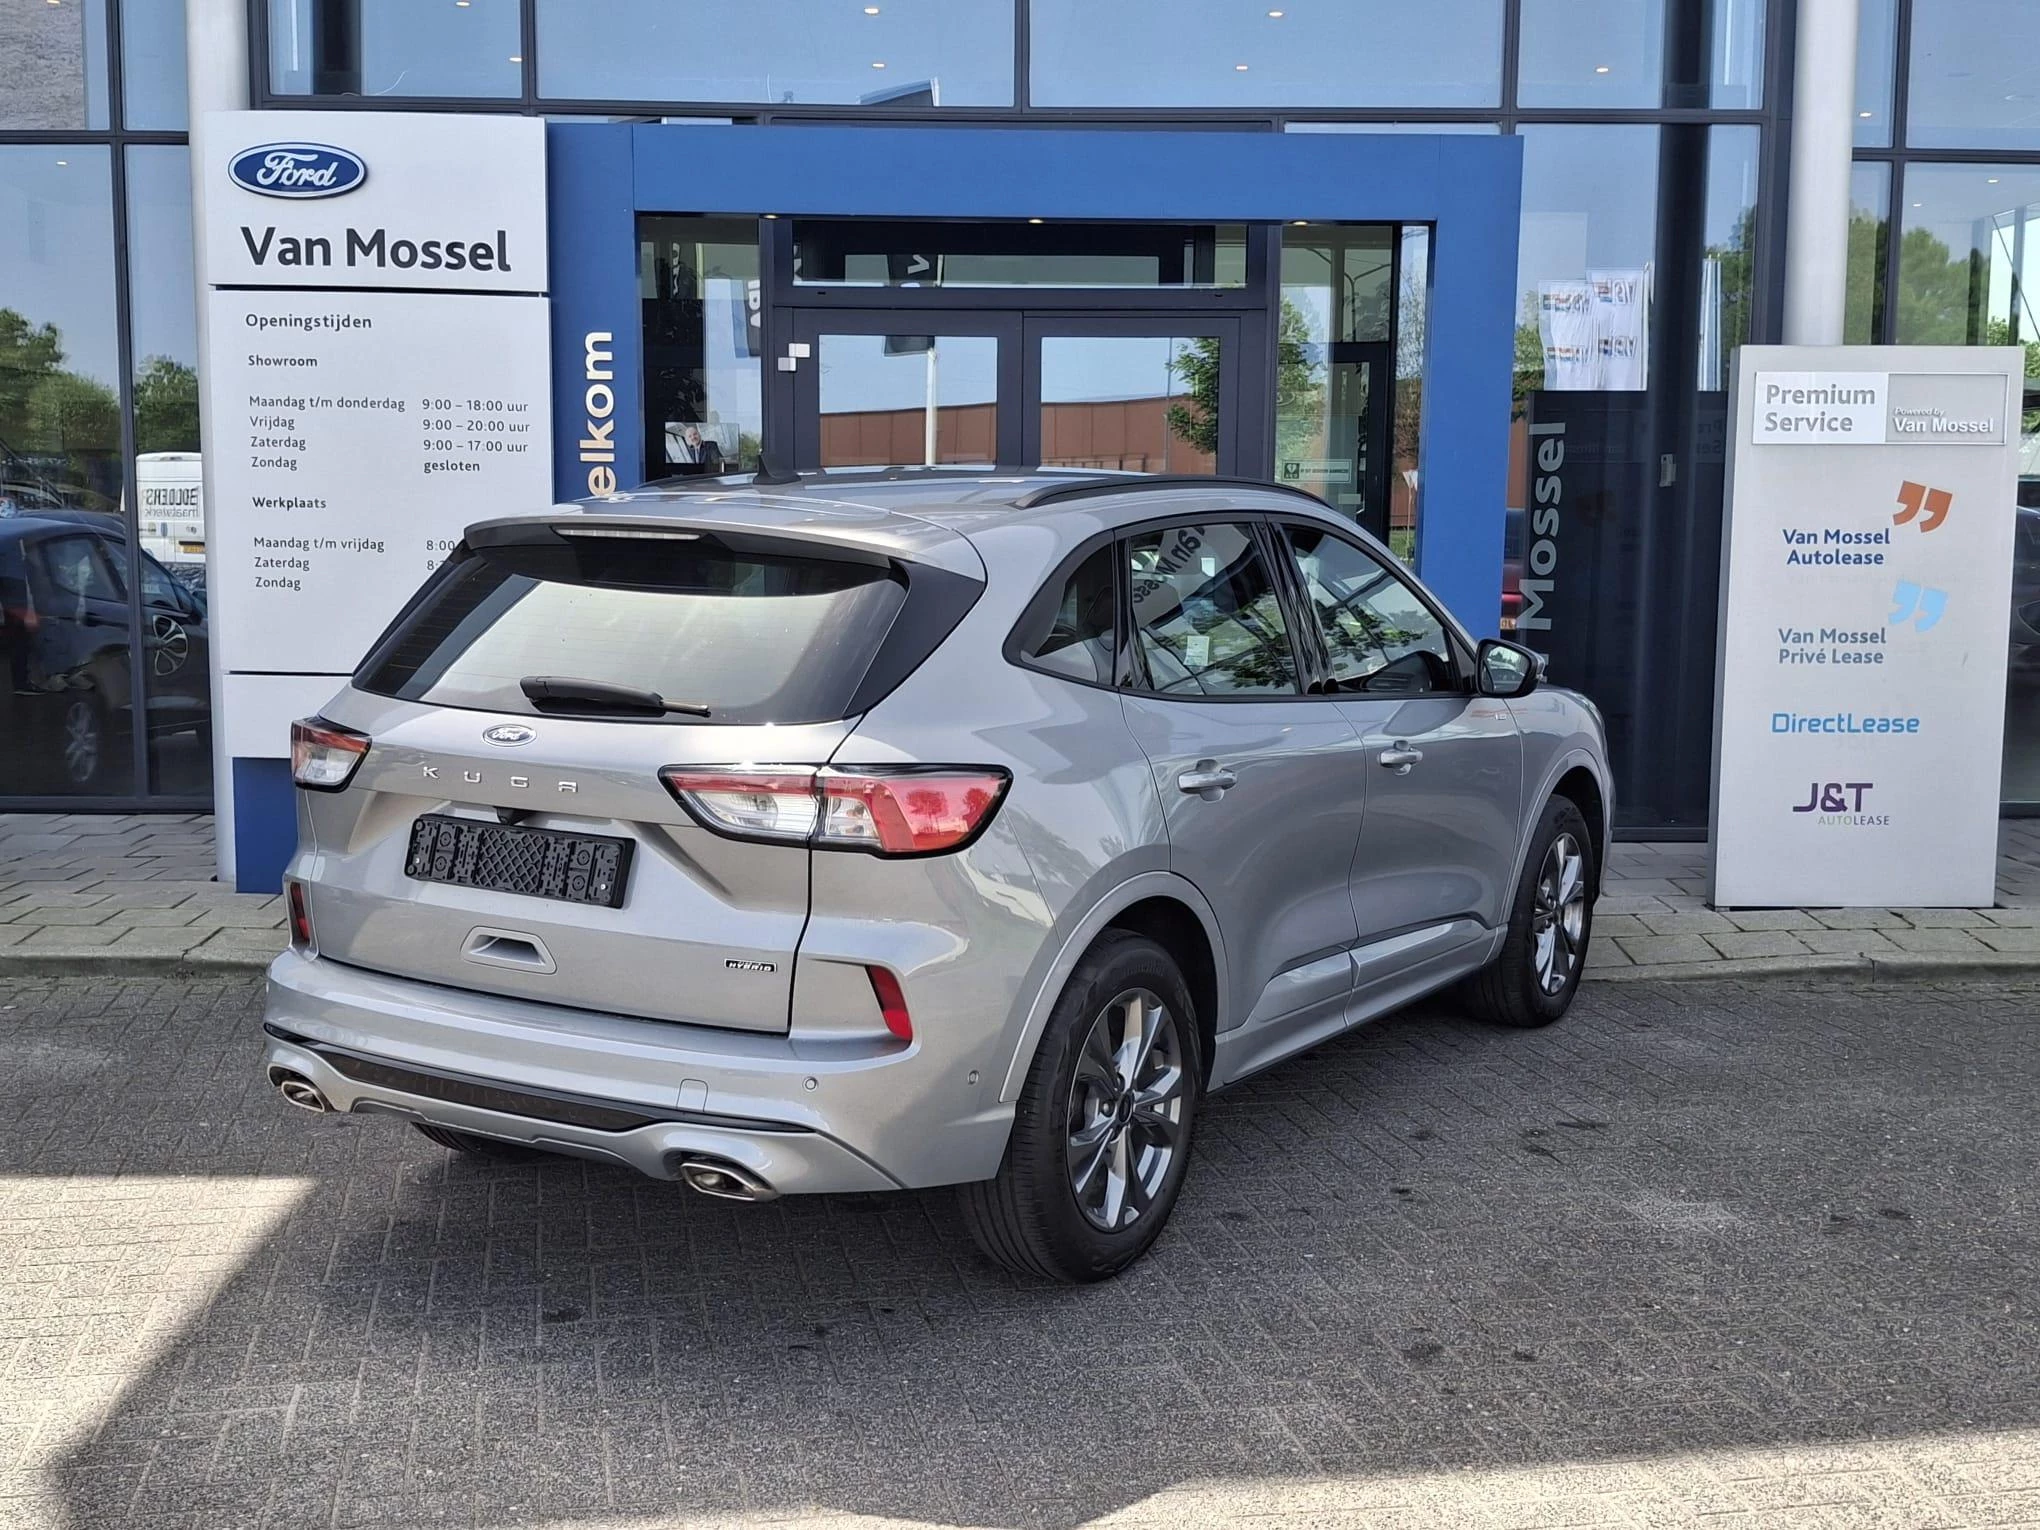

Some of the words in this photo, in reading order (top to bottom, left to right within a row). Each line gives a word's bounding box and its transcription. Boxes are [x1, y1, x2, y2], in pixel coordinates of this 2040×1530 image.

[257, 151, 339, 186] Ford
[240, 227, 331, 266] Van
[347, 228, 511, 271] Mossel
[246, 314, 371, 331] Openingstijden
[249, 355, 317, 366] Showroom
[1767, 384, 1875, 404] Premium
[250, 396, 305, 410] Maandag
[310, 396, 332, 408] t/m
[337, 397, 405, 412] donderdag
[423, 399, 451, 410] 9:00
[467, 400, 502, 411] 18:00
[580, 332, 616, 496] elkom
[1894, 407, 1933, 417] Powered
[1934, 407, 1945, 418] by
[250, 416, 295, 430] Vrijdag
[423, 419, 451, 430] 9:00
[467, 420, 504, 431] 20:00
[509, 424, 529, 432] uur
[1765, 411, 1852, 432] Service
[1893, 417, 1927, 433] Van
[1931, 417, 1994, 433] Mossel
[251, 436, 306, 451] Zaterdag
[424, 440, 452, 450] 9:00
[468, 441, 502, 451] 17:00
[507, 444, 528, 452] uur
[251, 456, 297, 471] Zondag
[424, 460, 479, 473] gesloten
[252, 497, 326, 511] Werkplaats
[1516, 423, 1566, 630] Mossel
[1783, 529, 1817, 544] Van
[1824, 528, 1890, 544] Mossel
[254, 537, 309, 551] Maandag
[314, 537, 336, 548] t/m
[341, 538, 384, 553] vrijdag
[426, 540, 455, 551] 8:00
[255, 557, 309, 571] Zaterdag
[1787, 549, 1884, 564] Autolease
[256, 577, 301, 591] Zondag
[1779, 628, 1813, 643] Van
[1820, 627, 1886, 643] Mossel
[1779, 648, 1826, 664] Privé
[1832, 649, 1883, 664] Lease
[1772, 713, 1920, 733] DirectLease
[422, 766, 578, 793] KUGA
[1793, 783, 1873, 812] J&T
[1818, 816, 1890, 825] AUTOLEASE
